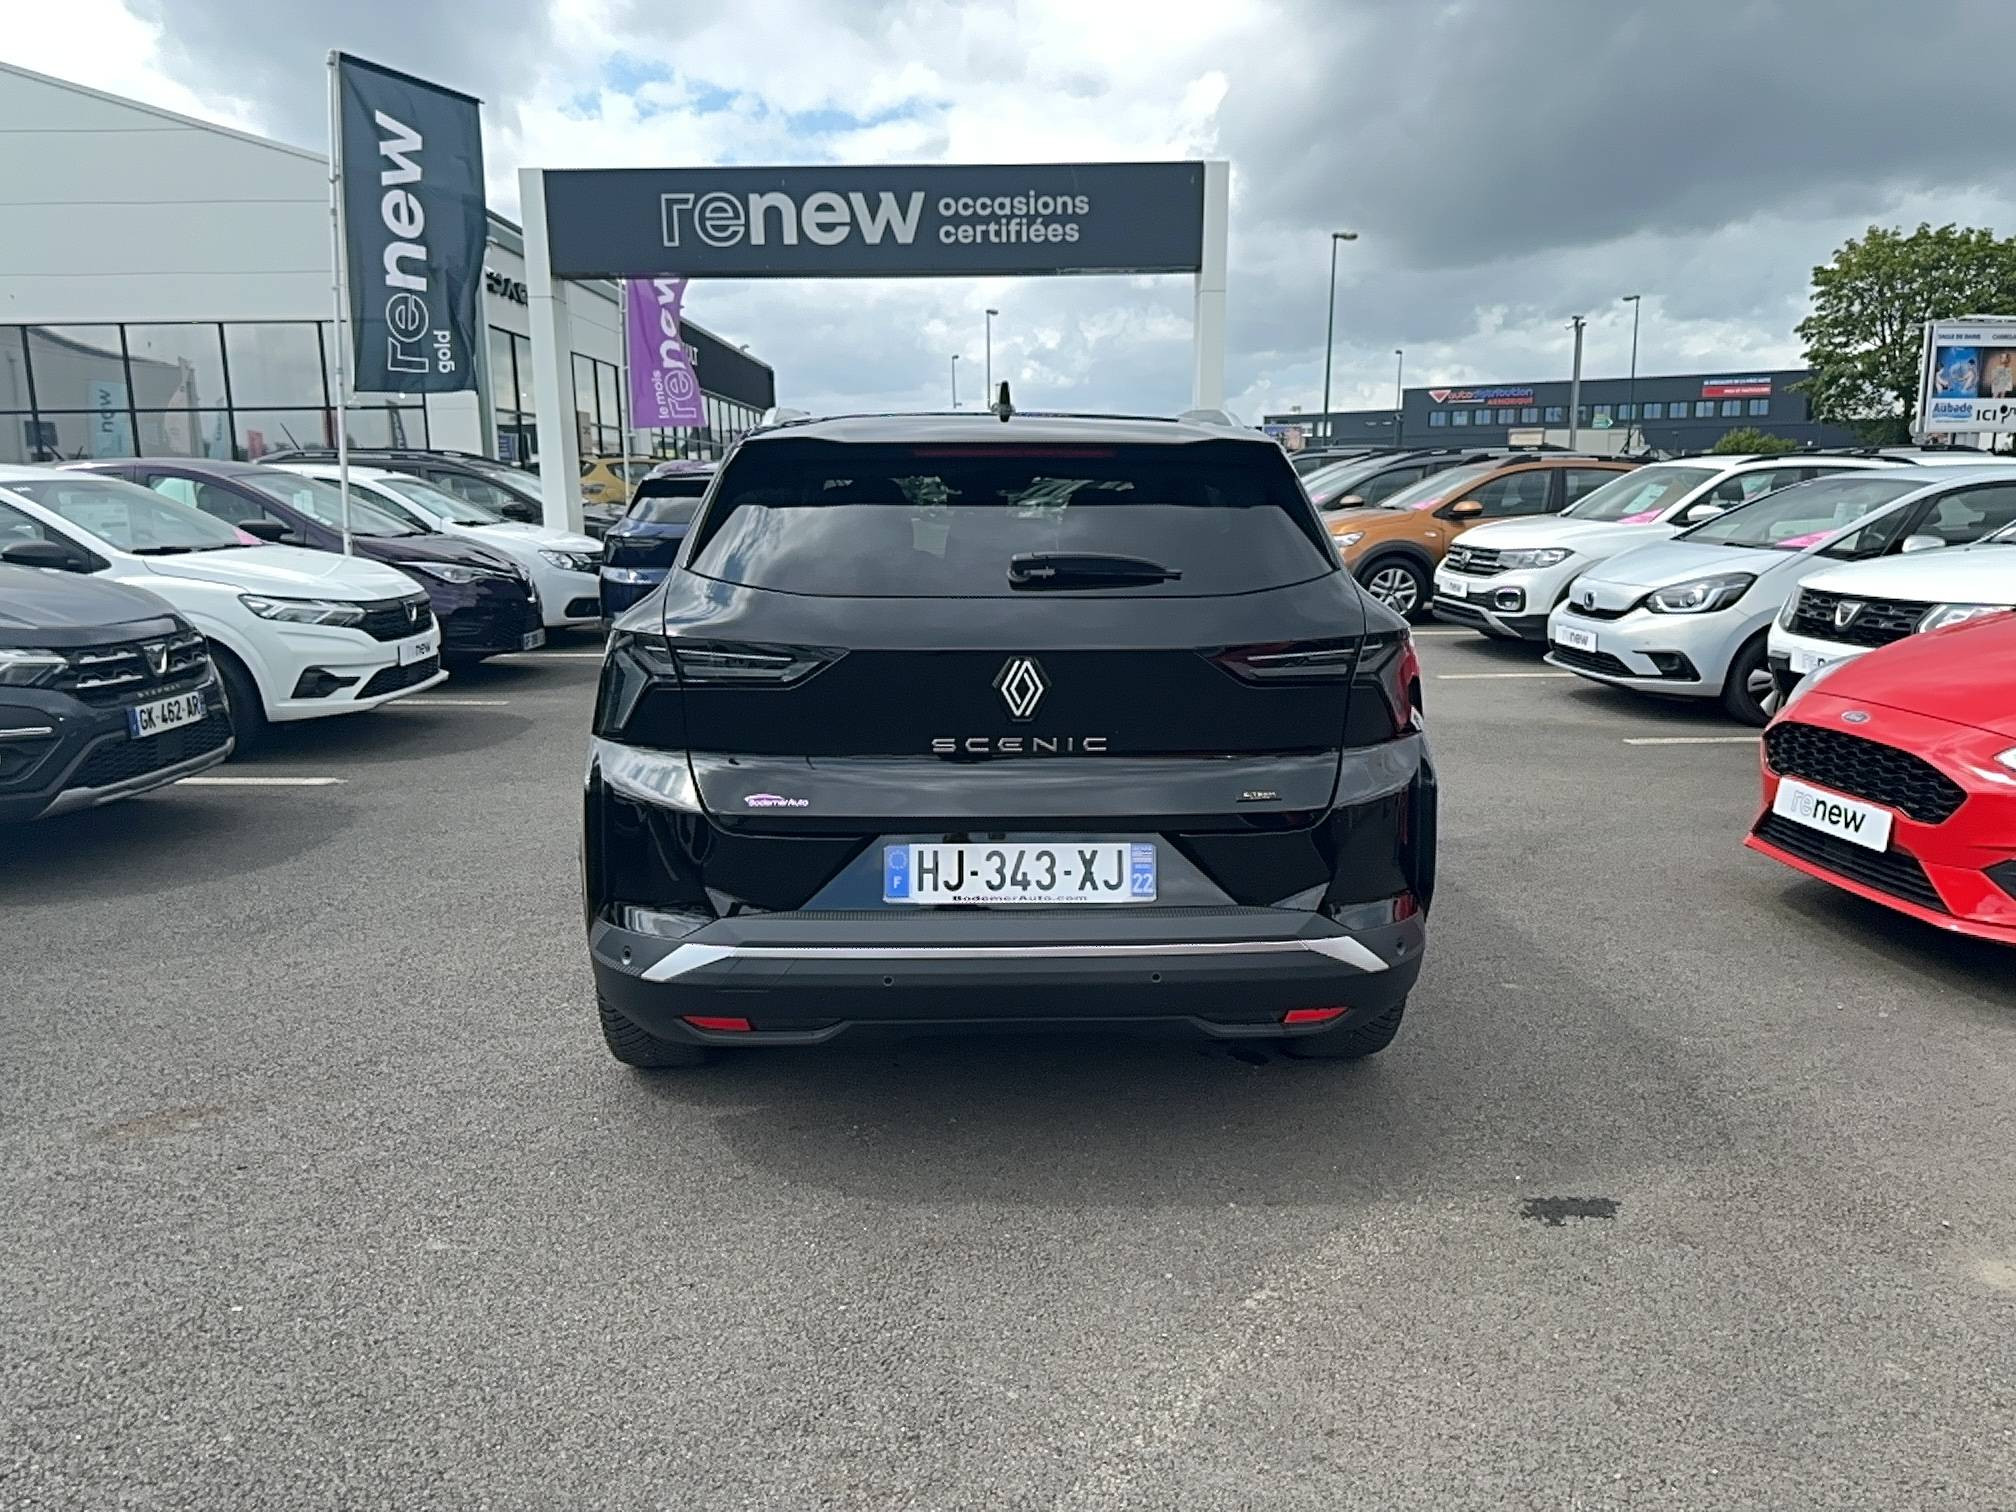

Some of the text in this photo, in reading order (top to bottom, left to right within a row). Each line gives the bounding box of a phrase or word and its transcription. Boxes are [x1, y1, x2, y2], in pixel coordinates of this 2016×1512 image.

[660, 191, 925, 248] renew
[938, 190, 1089, 217] occasions
[375, 109, 430, 373] renew
[939, 219, 1079, 244] certifiées
[433, 330, 455, 373] gold
[651, 369, 669, 419] le mois
[1933, 402, 1973, 413] Aubade
[1976, 409, 1997, 421] ICI
[140, 695, 199, 730] GK-462-AR
[931, 737, 1107, 752] SCENIC
[1790, 790, 1867, 833] renew
[893, 875, 901, 889] F
[917, 850, 1124, 892] HJ-343-XJ
[1132, 873, 1154, 893] 22
